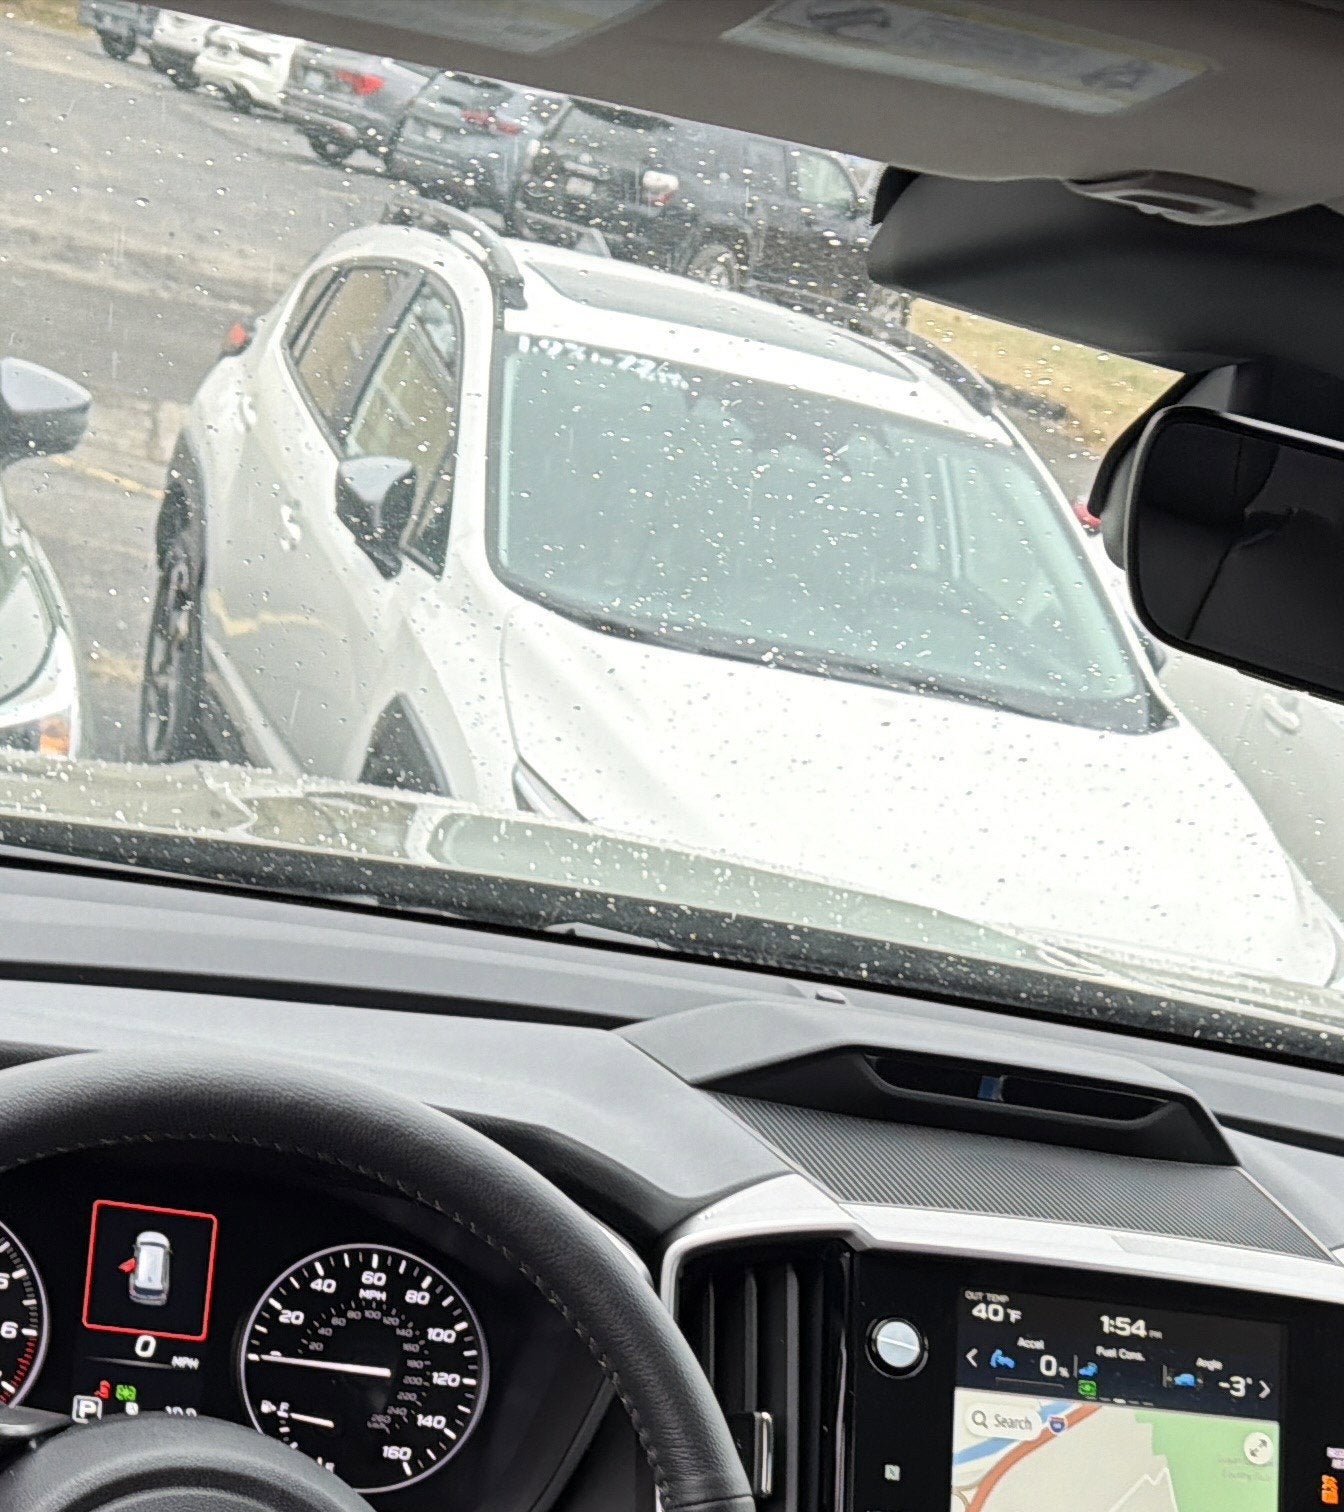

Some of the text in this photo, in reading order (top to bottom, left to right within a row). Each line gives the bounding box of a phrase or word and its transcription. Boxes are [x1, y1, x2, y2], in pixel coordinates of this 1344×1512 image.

[310, 1278, 336, 1294] 40
[361, 1271, 387, 1286] 60
[359, 1288, 387, 1301] MPH
[405, 1289, 430, 1305] 80
[279, 1310, 304, 1325] 20
[0, 1321, 17, 1339] 6
[1100, 1315, 1148, 1338] 1:54
[427, 1327, 457, 1344] 100
[135, 1335, 157, 1358] 0
[171, 1356, 200, 1370] MPH
[432, 1371, 461, 1387] 120
[79, 1400, 97, 1419] P
[417, 1414, 446, 1430] 140
[993, 1415, 1033, 1431] Search
[382, 1445, 412, 1461] 160
